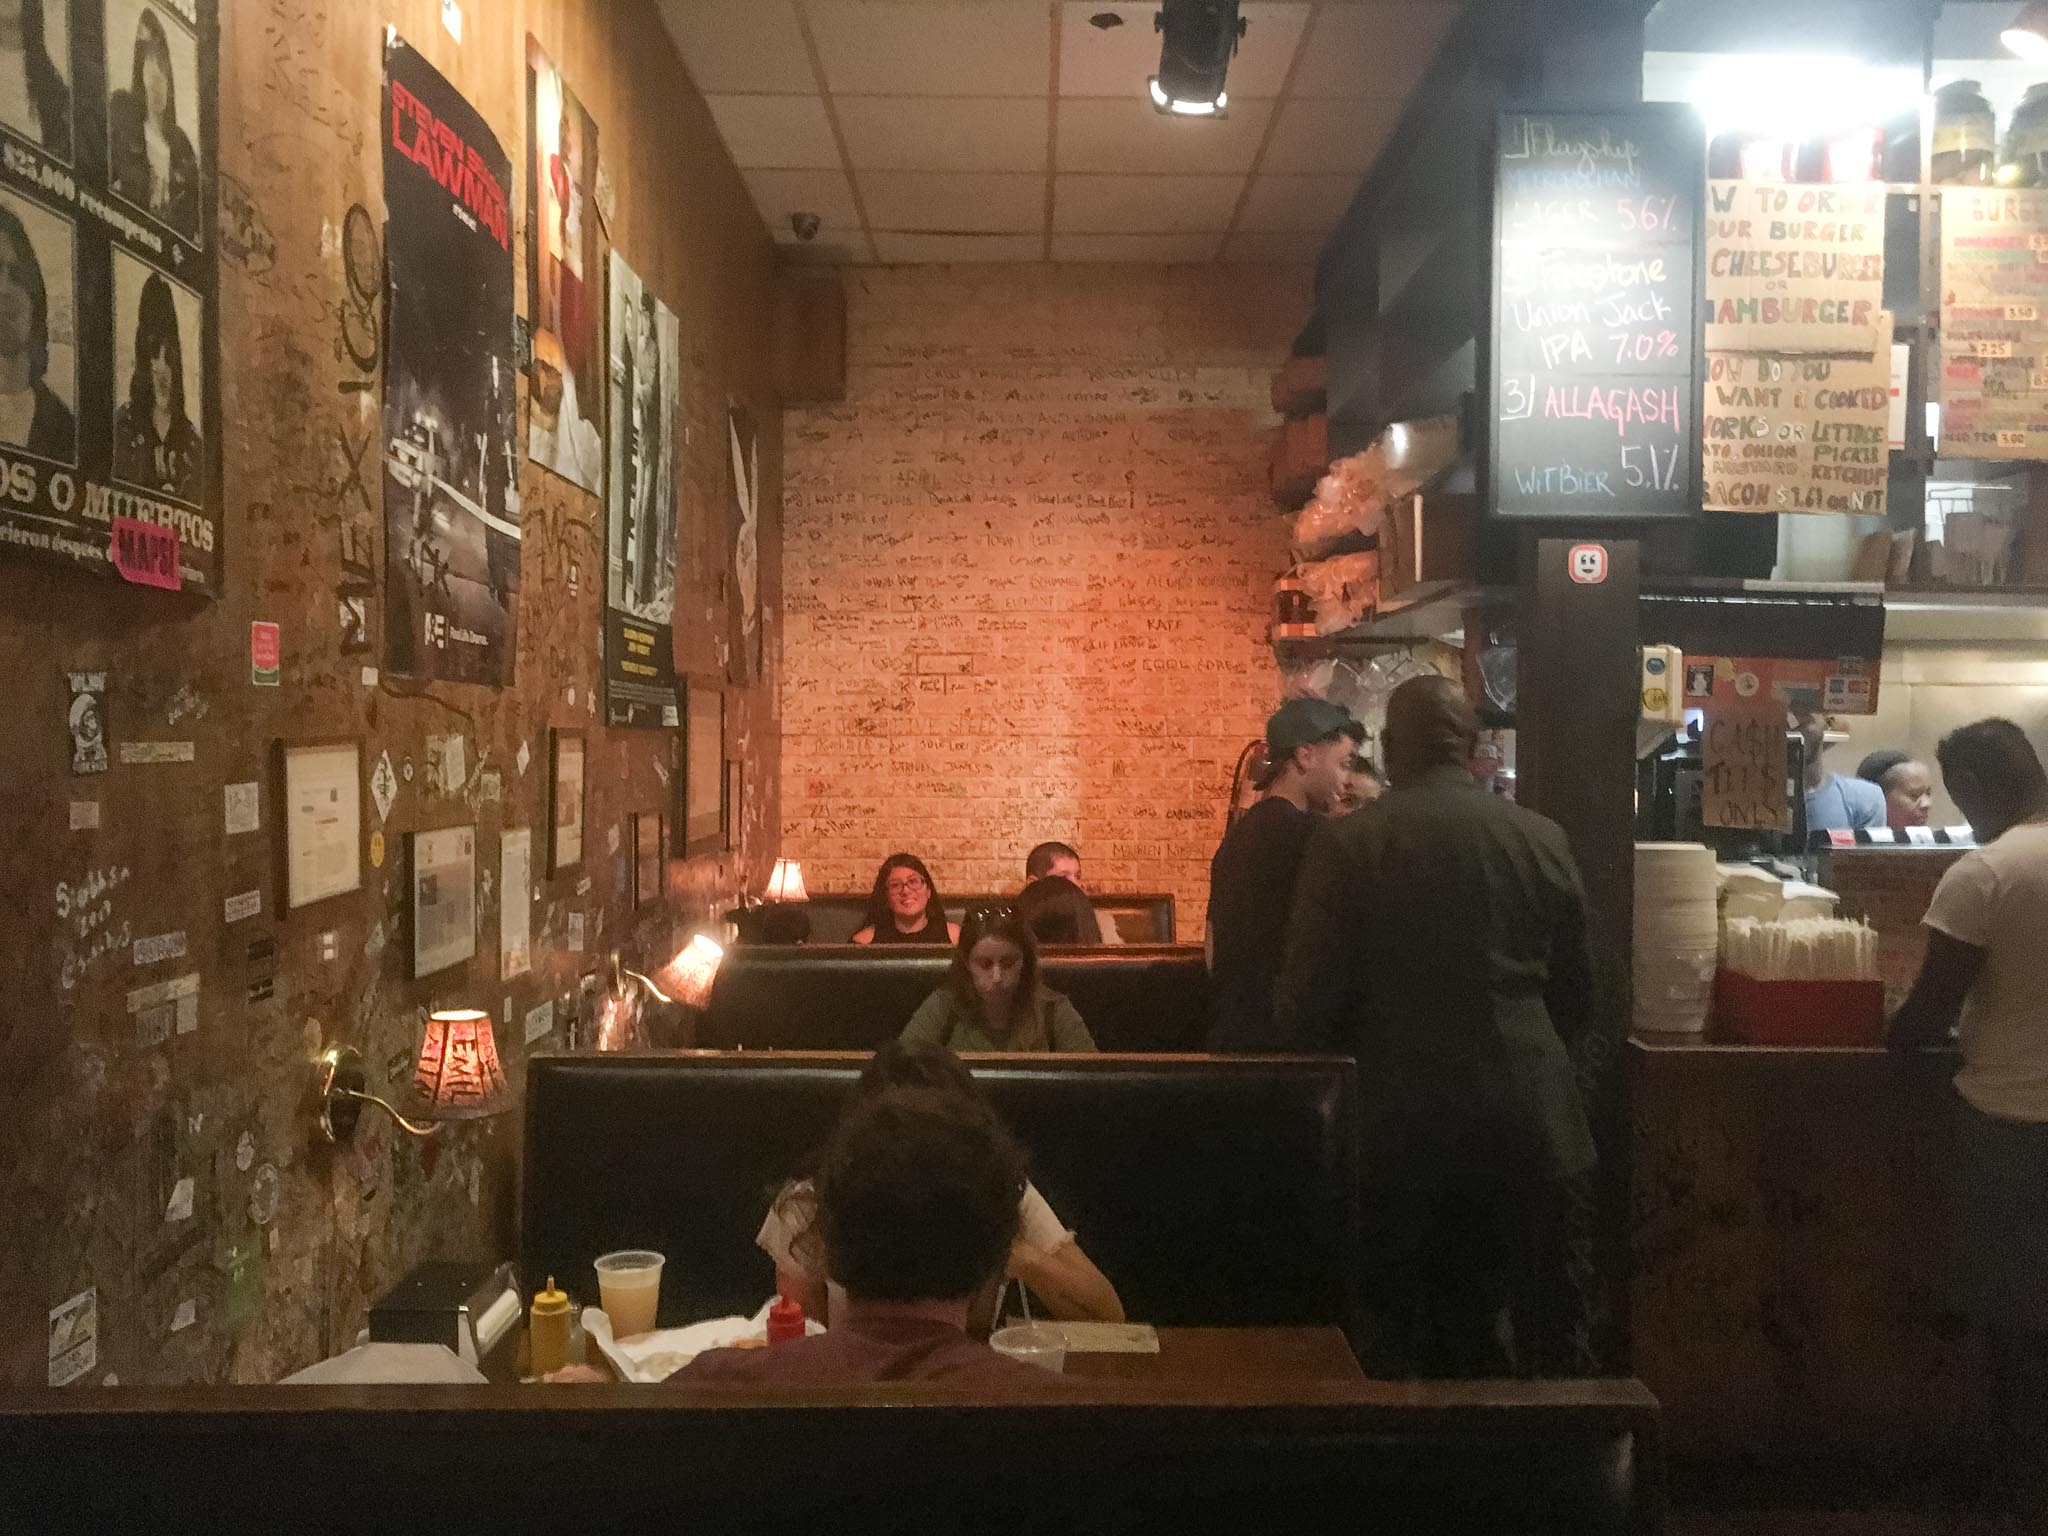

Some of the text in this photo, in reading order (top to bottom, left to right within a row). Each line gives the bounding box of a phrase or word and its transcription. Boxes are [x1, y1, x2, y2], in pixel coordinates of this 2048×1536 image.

[392, 104, 509, 252] LAWMAN
[1755, 186, 1788, 213] TO
[1769, 221, 1867, 242] BURGER
[1595, 289, 1673, 328] Jack
[1539, 329, 1680, 370] IPA 7.0%
[1544, 385, 1681, 437] ALLAGASH
[1716, 385, 1784, 409] WANT
[1620, 443, 1680, 491] 5.1%
[49, 471, 75, 513] O
